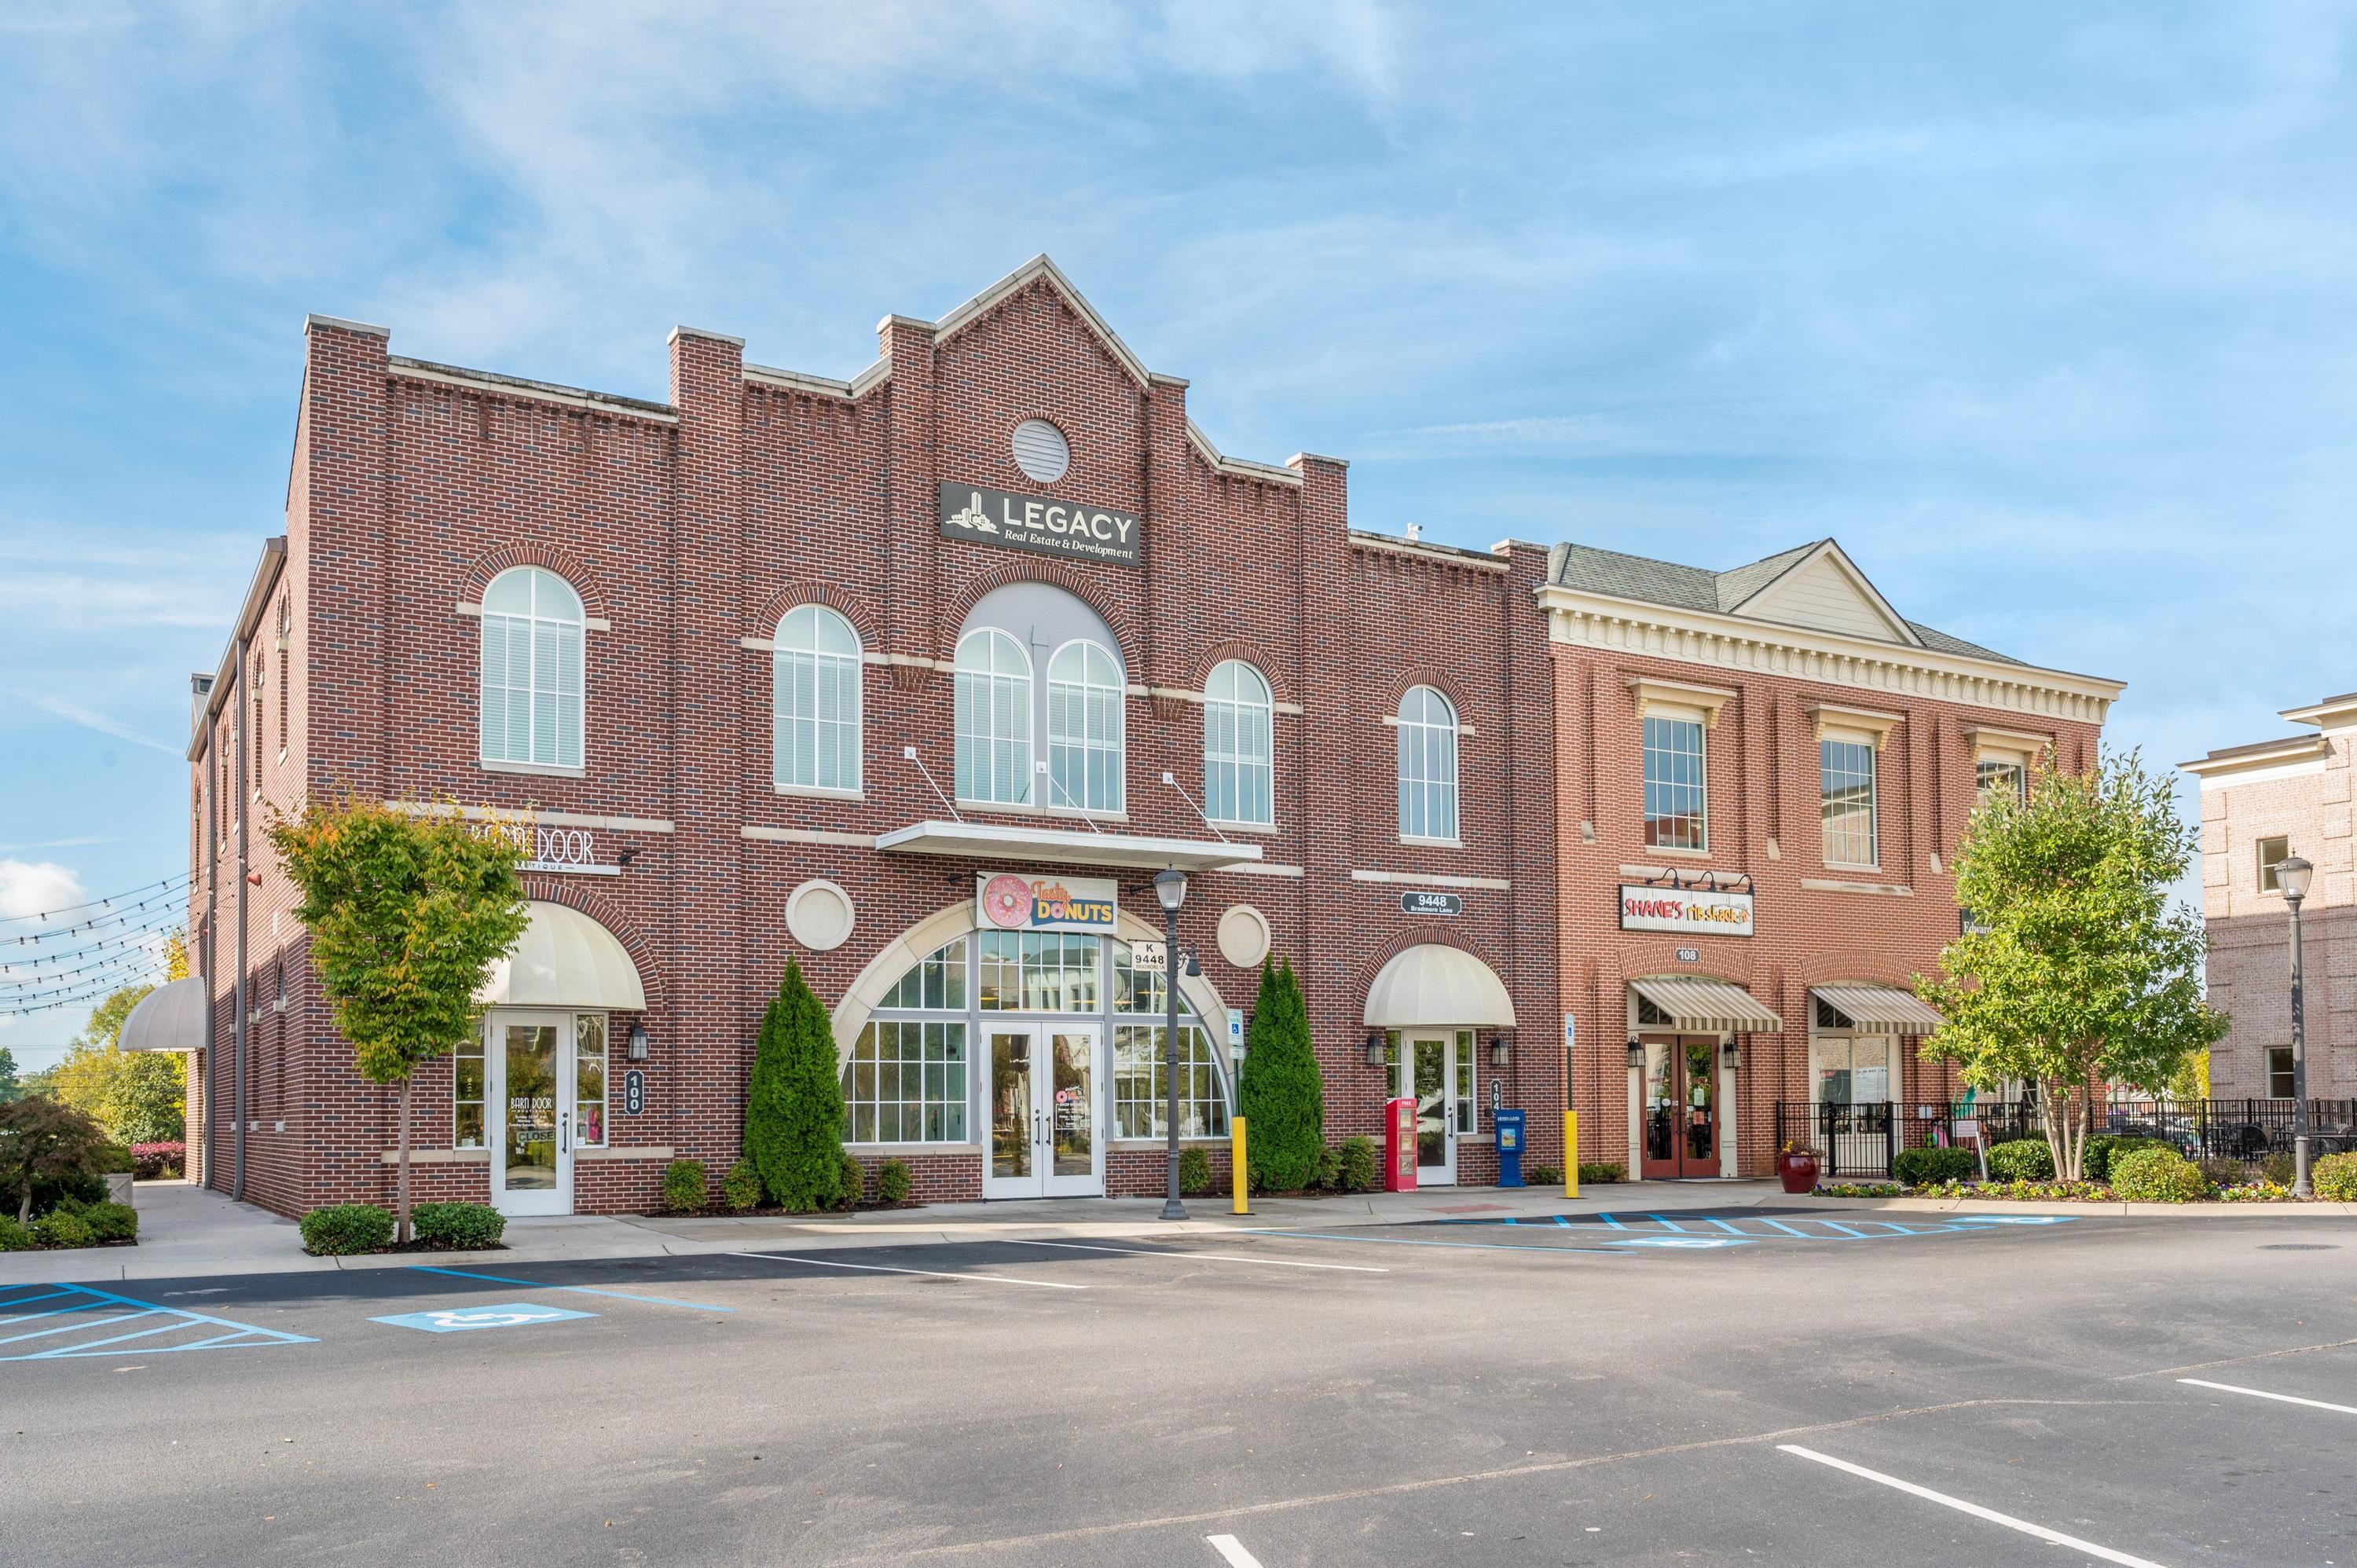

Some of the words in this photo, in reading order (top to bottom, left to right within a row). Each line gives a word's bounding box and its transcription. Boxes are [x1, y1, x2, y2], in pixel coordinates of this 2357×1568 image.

[1004, 498, 1132, 543] LEGACY
[1004, 529, 1027, 542] Real
[1029, 533, 1061, 548] Estate
[1062, 539, 1070, 549] &
[1072, 540, 1133, 559] Development
[537, 828, 595, 865] DOOR
[1031, 881, 1072, 910] Tasty
[1418, 895, 1446, 907] 9448
[1038, 902, 1113, 922] DONUTS
[1625, 898, 1684, 921] SHANE'S
[1964, 921, 1992, 934] Edward
[1146, 943, 1154, 953] K
[1678, 950, 1697, 961] 108
[1135, 954, 1164, 964] 9448
[630, 1075, 640, 1110] 100
[511, 1097, 530, 1109] BARN
[532, 1097, 552, 1109] DOOR
[519, 1131, 555, 1141] CLOSE
